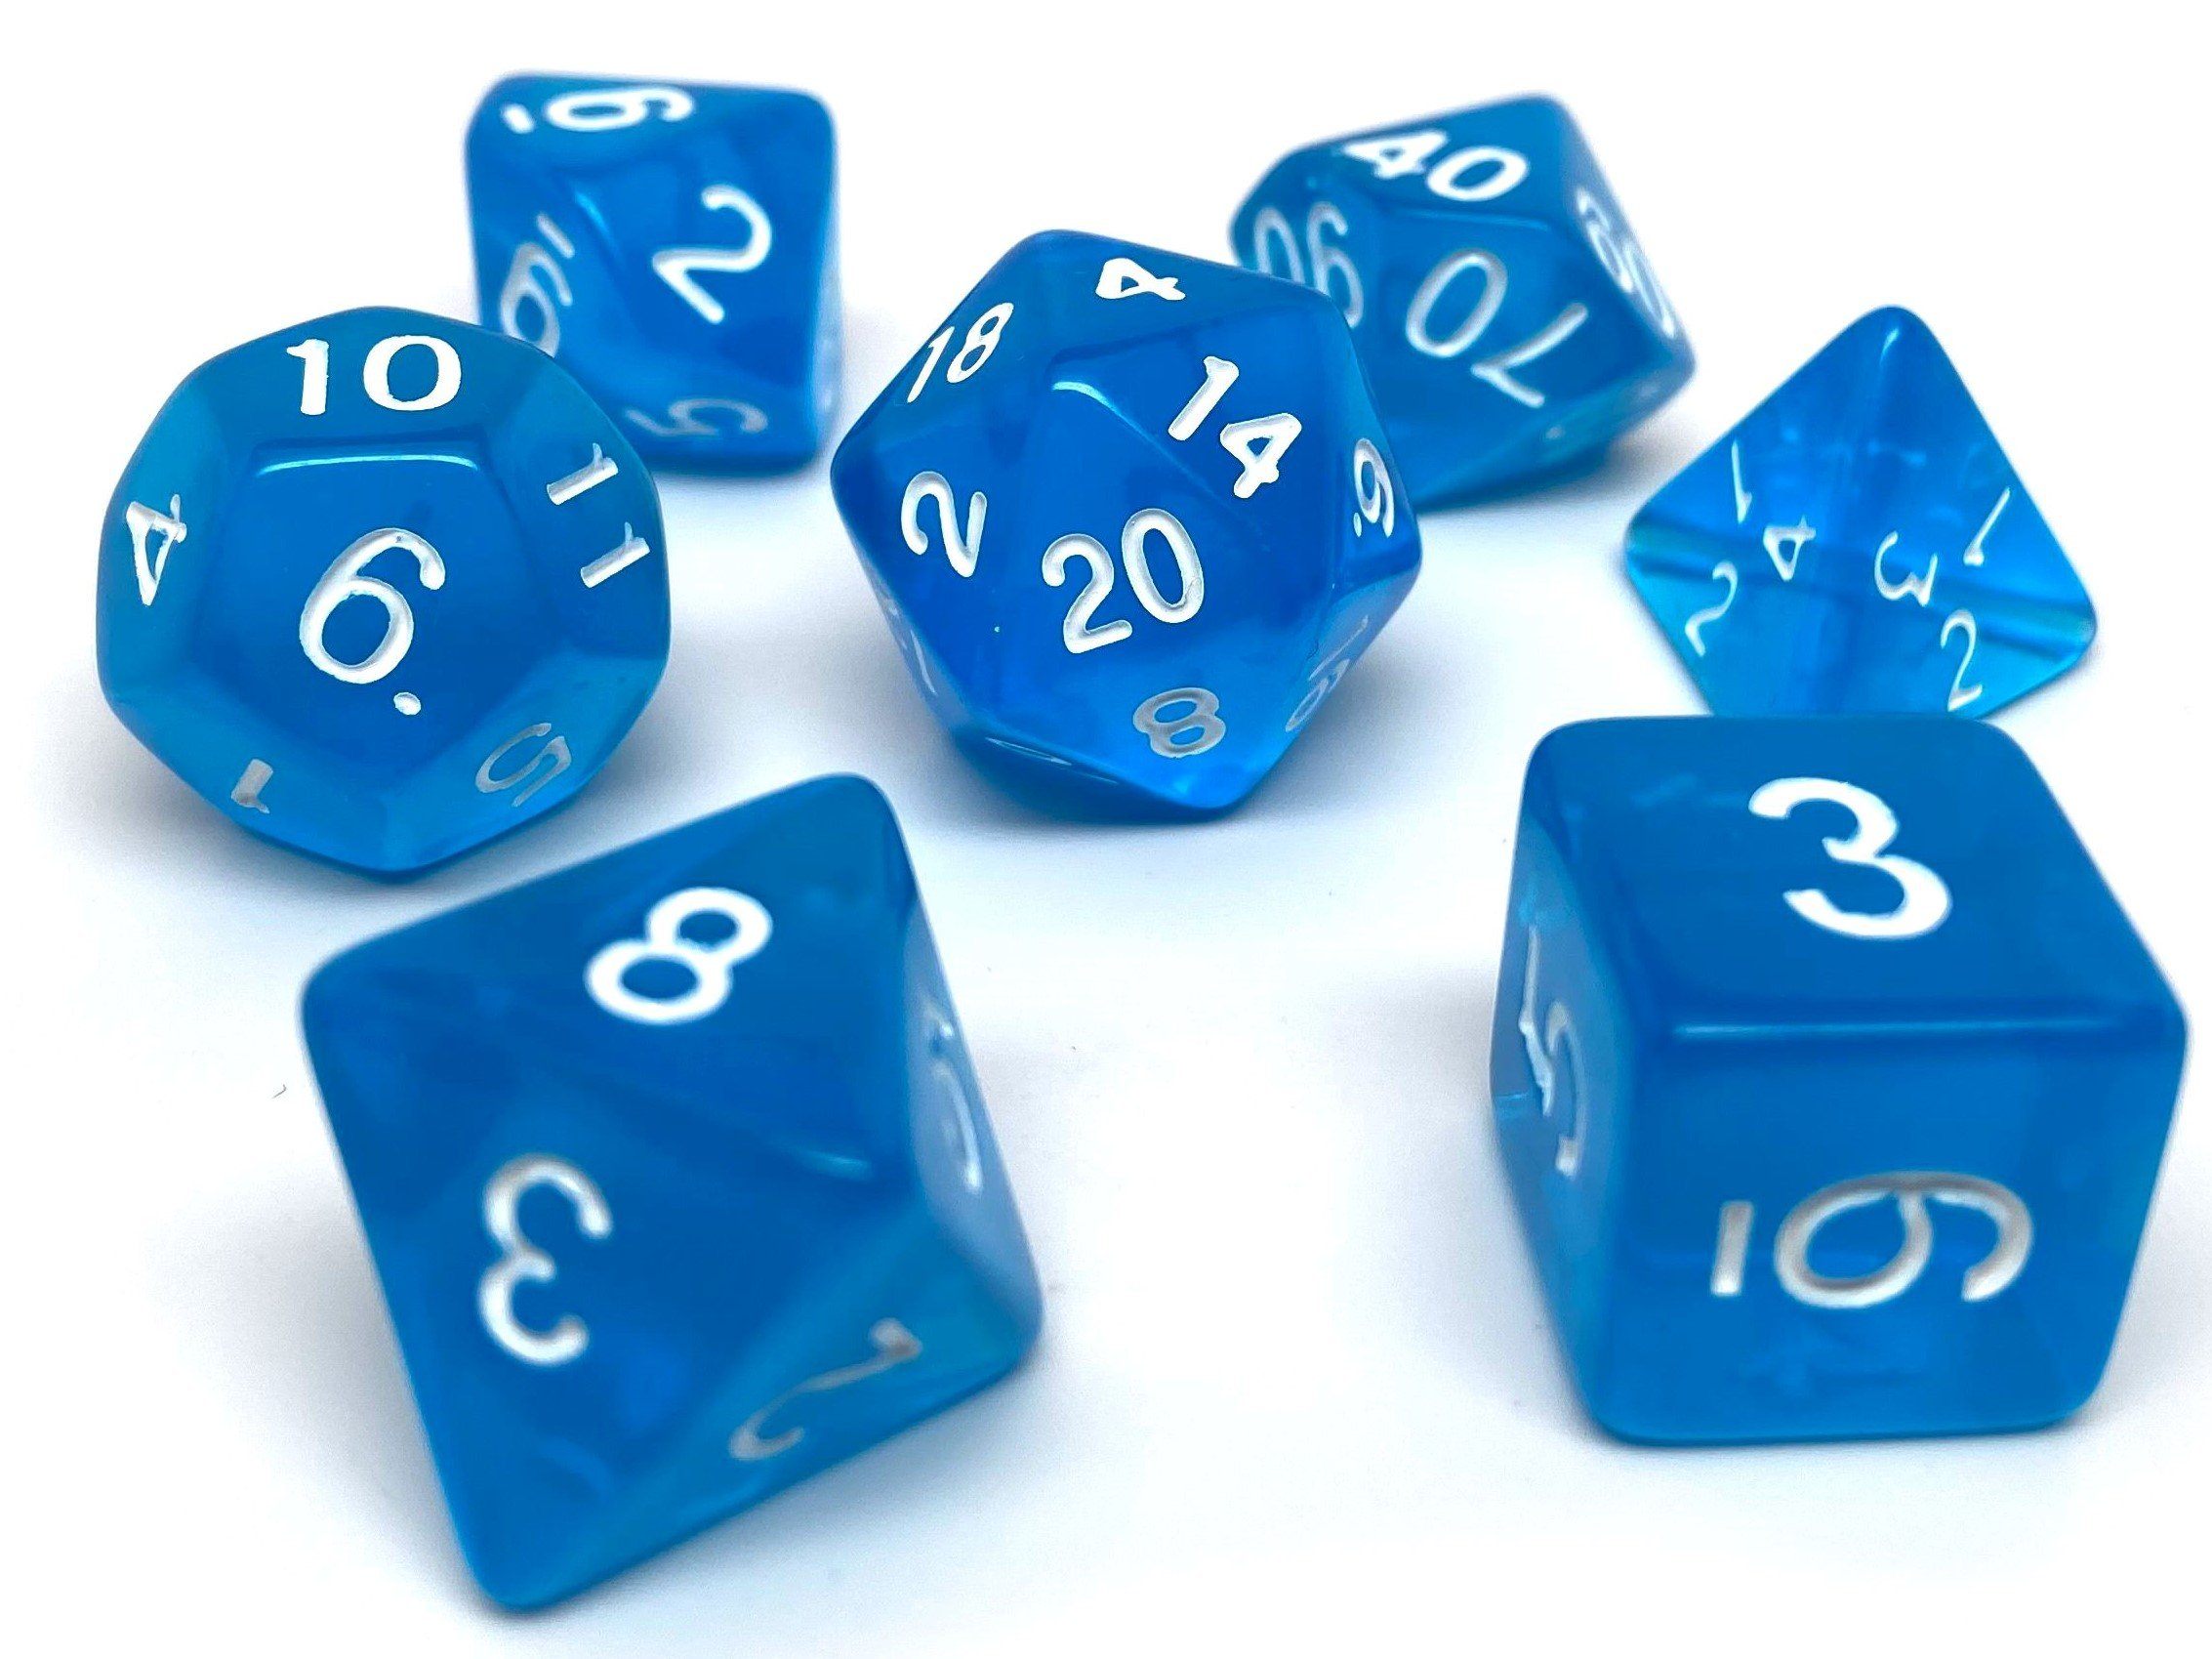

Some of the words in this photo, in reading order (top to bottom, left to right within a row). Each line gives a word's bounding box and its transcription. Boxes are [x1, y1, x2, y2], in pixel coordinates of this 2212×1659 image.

[1343, 129, 1528, 201] 40
[653, 186, 771, 323] 2
[1095, 257, 1186, 300] 4
[287, 335, 461, 415] 10
[908, 303, 1013, 402] 18
[1168, 356, 1301, 498] 14
[126, 494, 186, 605] 4
[547, 444, 650, 588] 11
[901, 472, 987, 577] 2
[1763, 519, 1816, 581] 4
[1042, 509, 1204, 653] 20
[1685, 562, 1738, 656] 2
[1875, 532, 1938, 606] 3
[1941, 610, 1983, 711] 2
[475, 723, 571, 807] 5
[1133, 687, 1226, 758] 8
[1749, 778, 1949, 938] 3
[587, 888, 771, 1023] 8
[478, 1157, 612, 1365] 3
